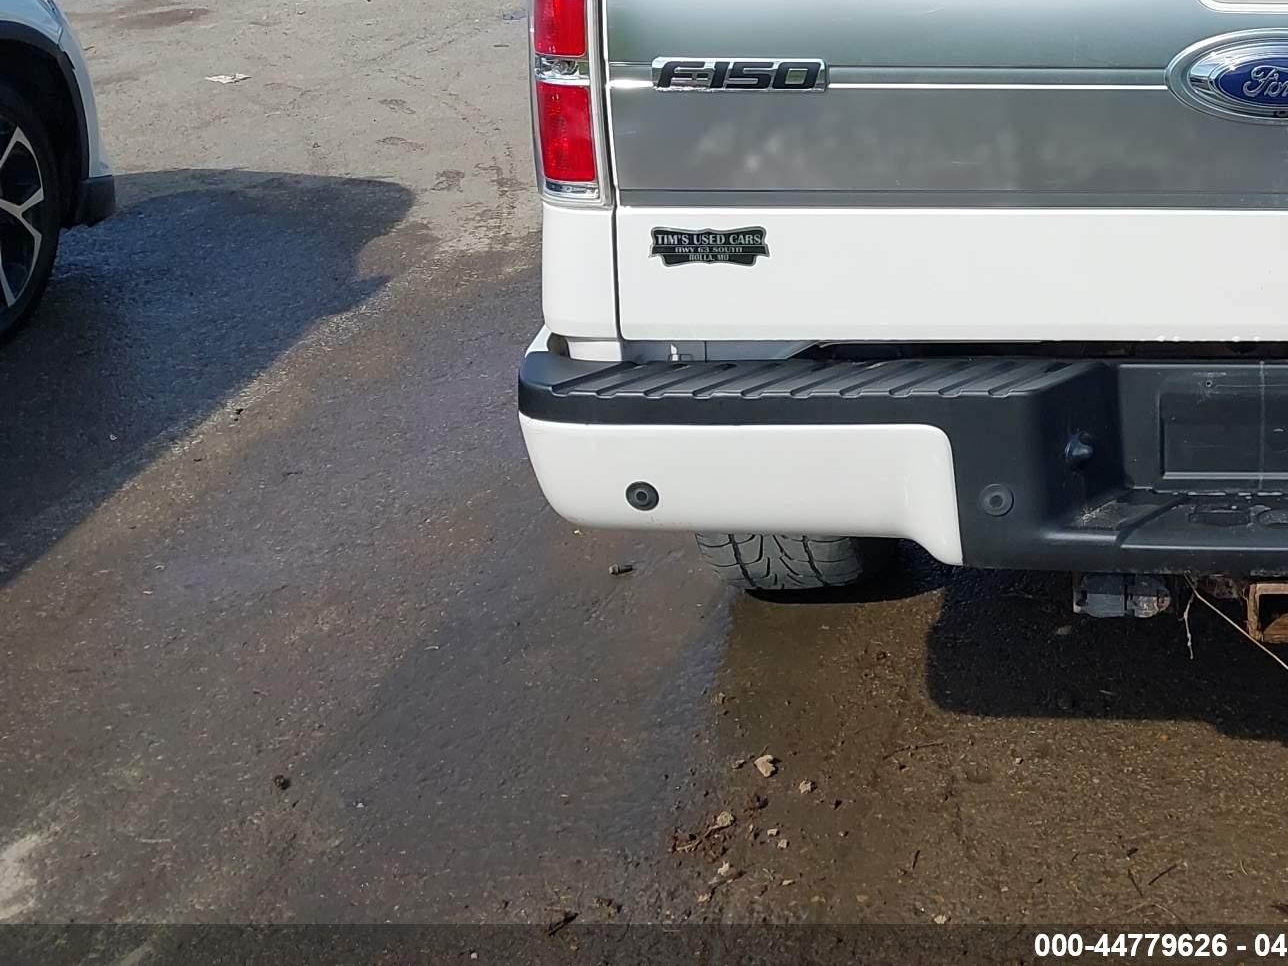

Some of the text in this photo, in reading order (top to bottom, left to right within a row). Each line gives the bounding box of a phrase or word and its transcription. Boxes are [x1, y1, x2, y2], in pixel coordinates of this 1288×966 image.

[655, 59, 824, 91] F-150
[656, 234, 762, 245] TIM'S USED CARS
